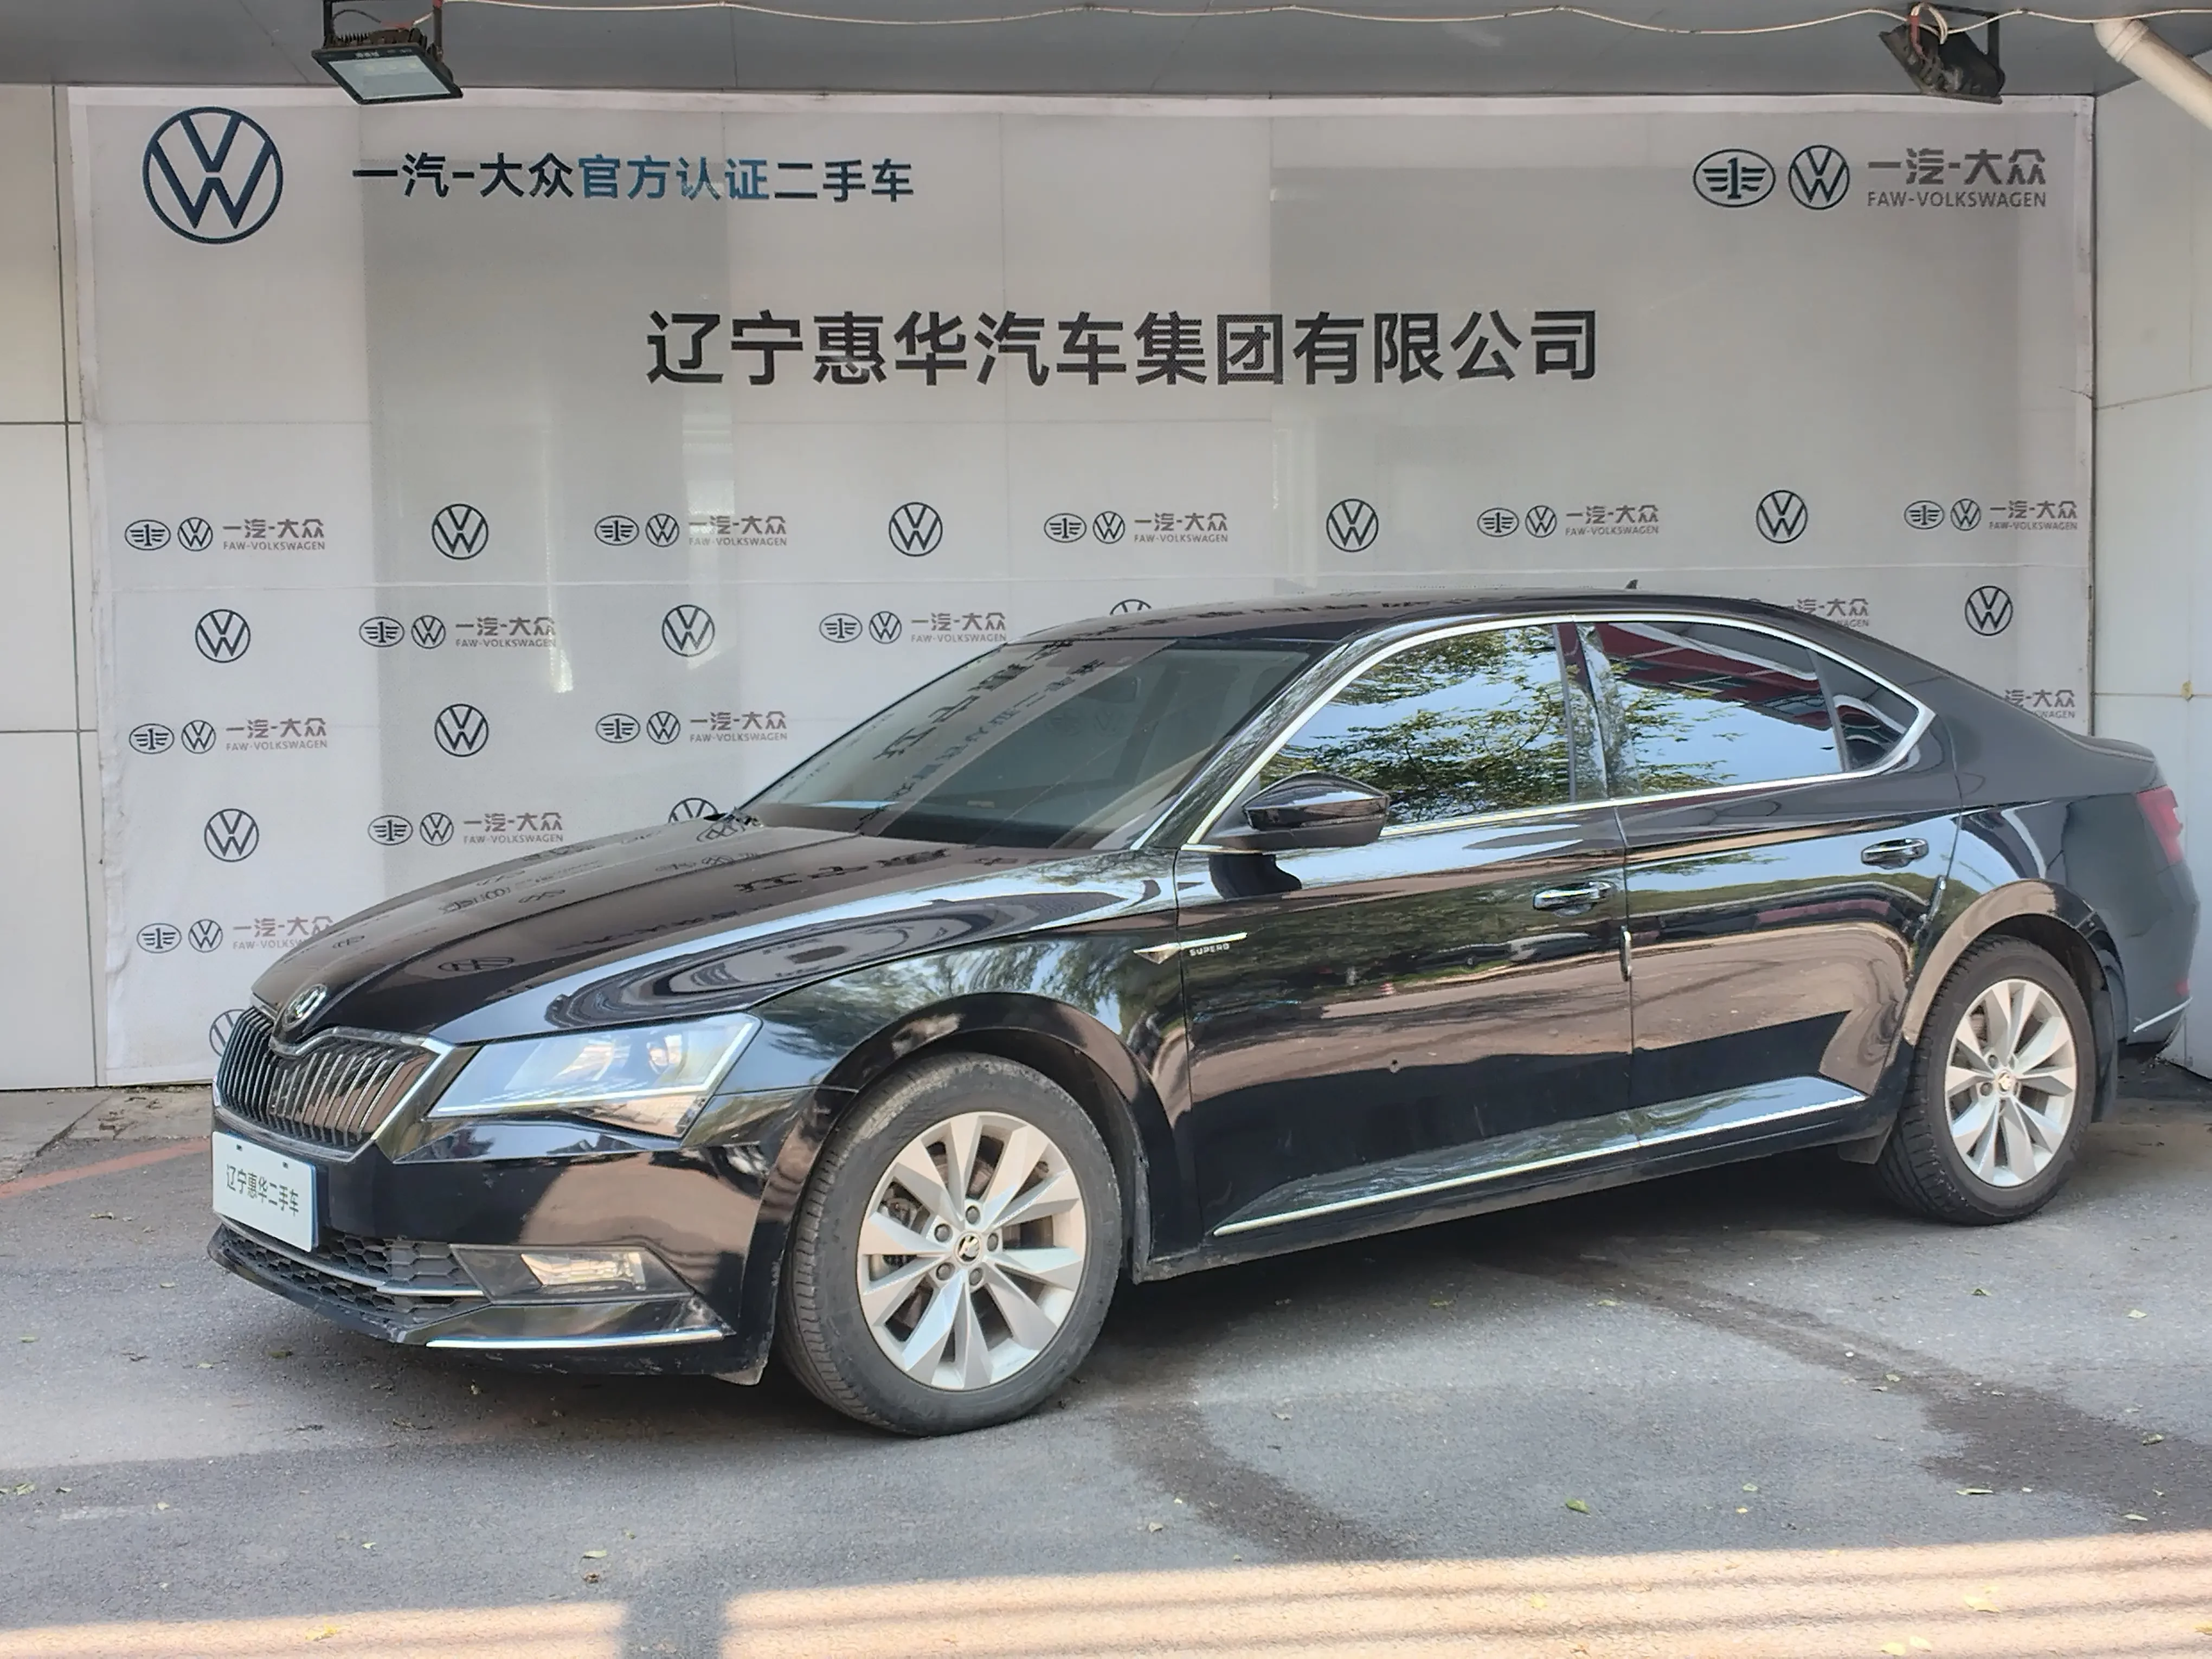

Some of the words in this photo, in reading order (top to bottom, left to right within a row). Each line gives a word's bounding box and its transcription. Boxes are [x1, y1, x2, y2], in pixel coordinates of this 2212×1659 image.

[1868, 149, 2046, 185] 一汽-大众
[352, 152, 914, 202] 一汽-大众官方认证二手车
[1868, 191, 2046, 208] FAW-VOLKSWAGEN
[646, 310, 1596, 386] 辽宁惠华汽车集团有限公司
[1566, 505, 1658, 524] 一汽-大众
[1990, 500, 2076, 518] 一汽-大众
[223, 519, 324, 538] 一汽-大众
[689, 516, 786, 535] 一汽-大众
[1135, 513, 1227, 531] 一汽-大众
[1565, 525, 1658, 536] FAW-VOLKSWAGEN
[1989, 522, 2077, 530] FAW-VOLKSWAGEN
[223, 541, 325, 550] FAW-VOLKSWAGEN
[689, 537, 787, 546] FAW-VOLKSWAGEN
[1134, 533, 1227, 543] FAW-VOLKSWAGEN
[1787, 599, 1868, 616] 汽-大众
[455, 617, 554, 636] 一汽-大众
[911, 612, 1006, 631] 一汽-大众
[456, 639, 555, 647] FAW-VOLKSWAGEN
[911, 633, 1006, 642] FAW-VOLKSWAGEN
[226, 718, 326, 738] 一汽-大众
[690, 711, 786, 731] 一汽-大众
[226, 740, 327, 751] FAW-VOLKSWAGEN
[690, 732, 787, 742] FAW-VOLKSWAGEN
[464, 812, 563, 832] 一汽-大众
[464, 834, 563, 844] FAW-VOLKSWAGEN
[1189, 943, 1230, 956] SUPERB
[226, 1163, 299, 1216] 辽宁惠华二手车
